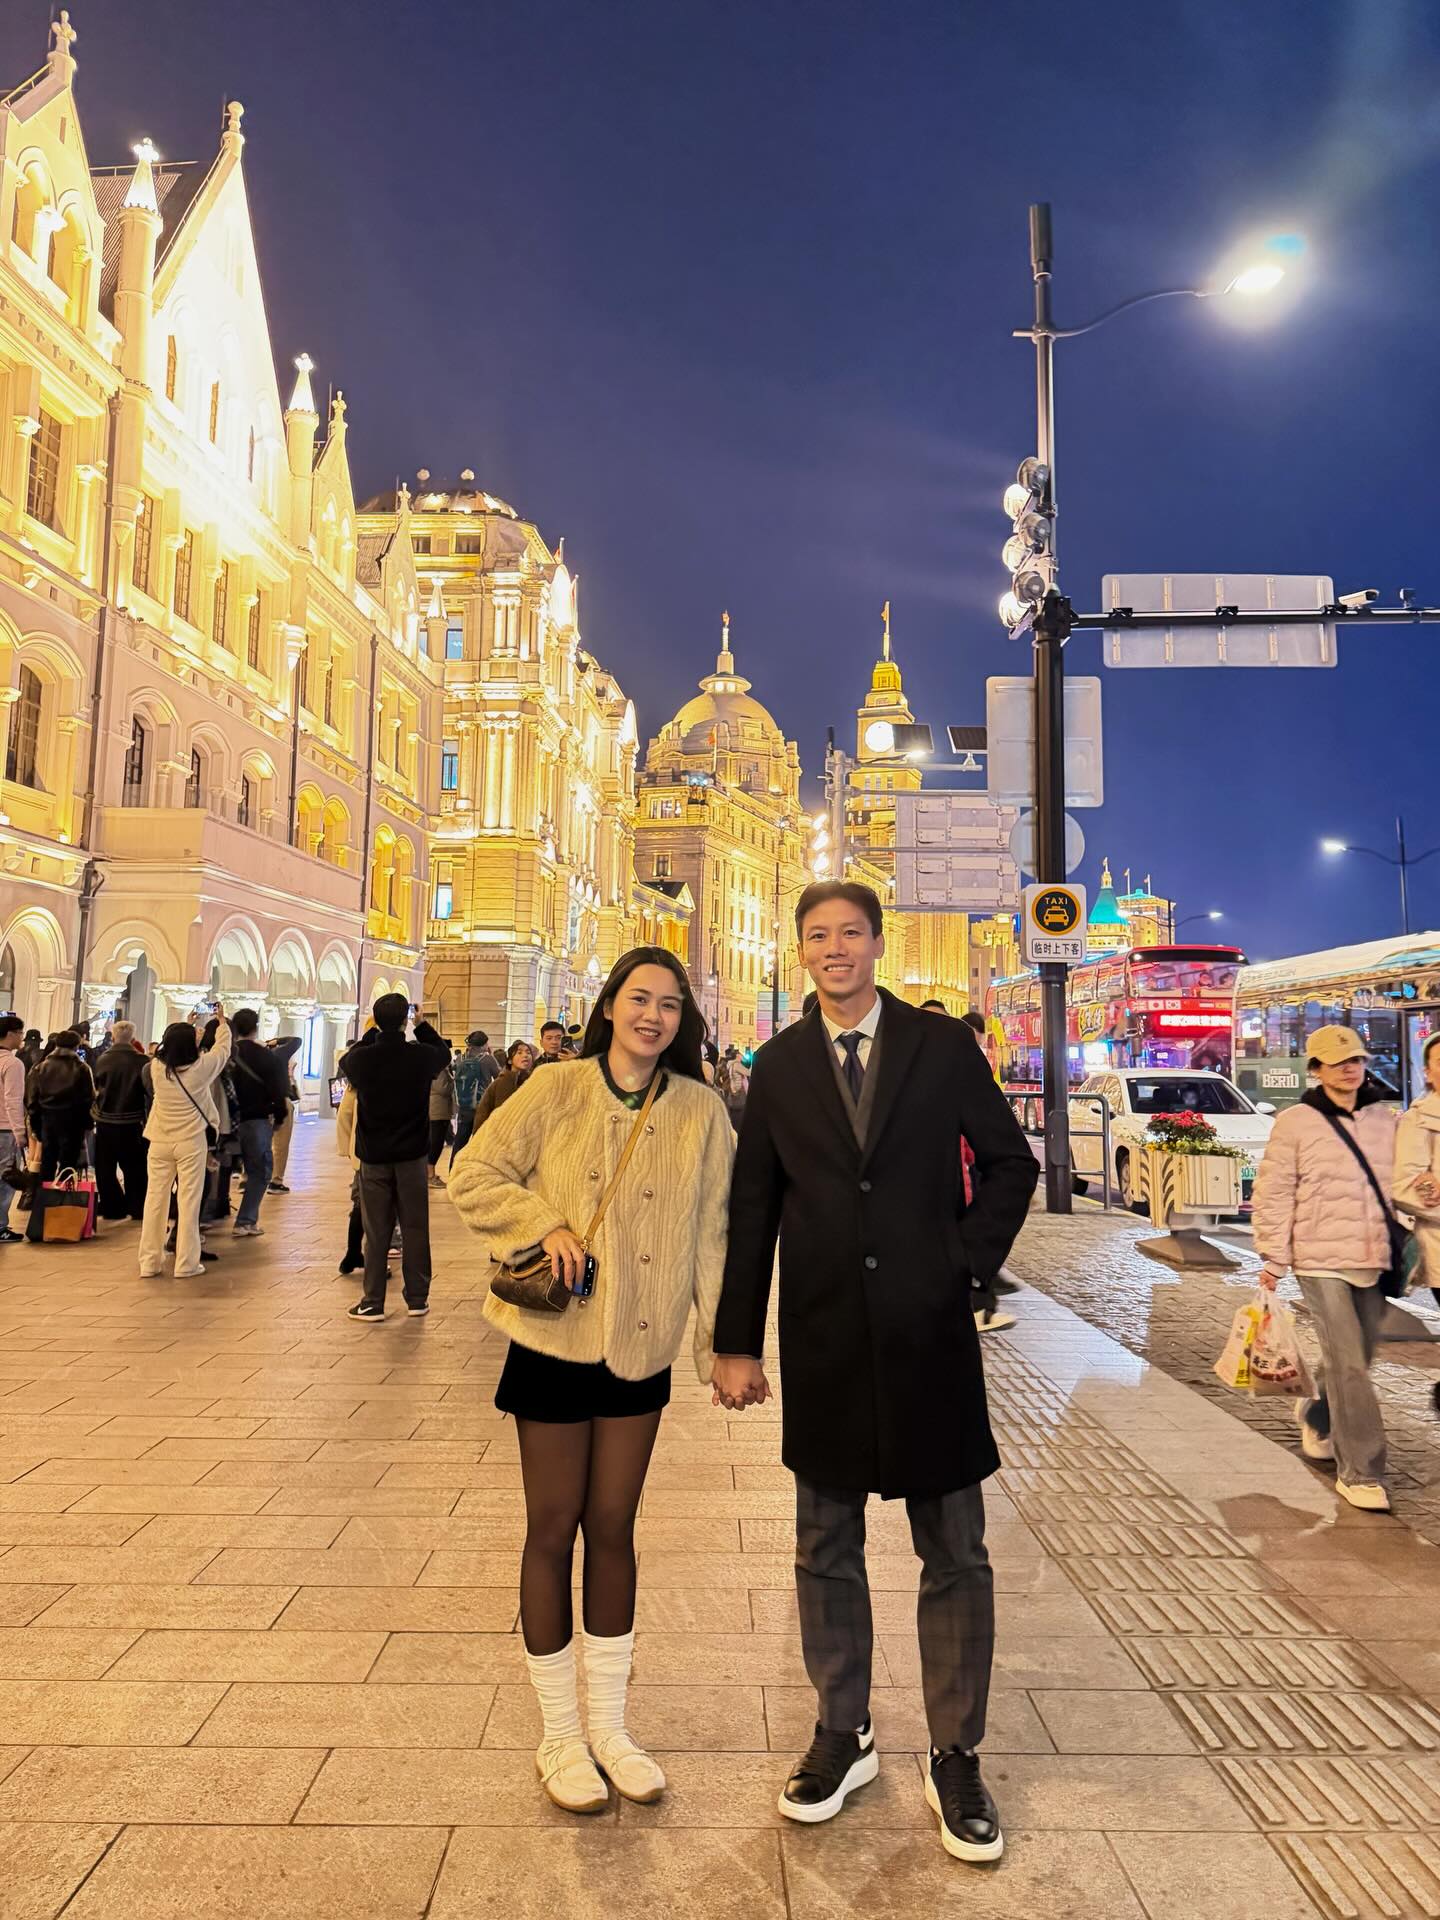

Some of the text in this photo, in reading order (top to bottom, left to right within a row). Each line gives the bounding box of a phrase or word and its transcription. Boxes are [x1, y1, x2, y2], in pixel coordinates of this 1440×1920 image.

[1045, 897, 1068, 905] TAXI
[1034, 942, 1079, 955] 临时上下客
